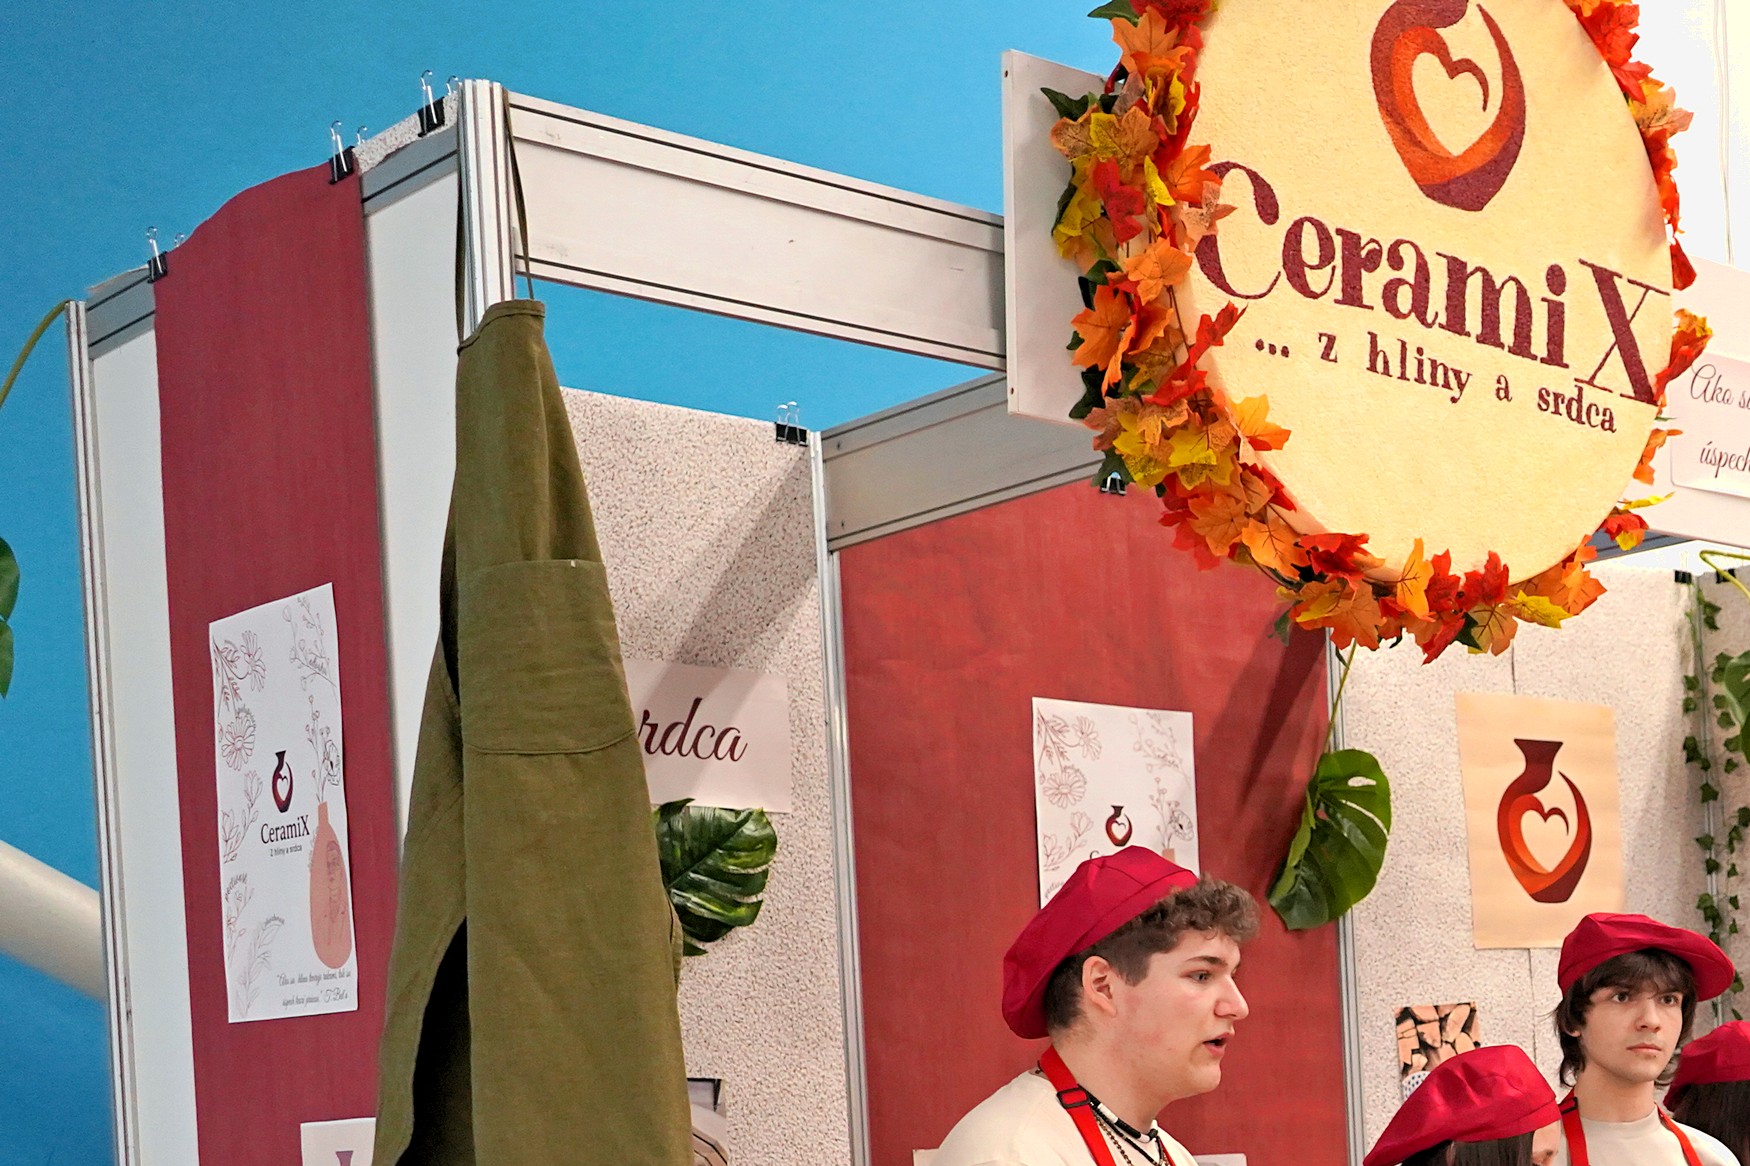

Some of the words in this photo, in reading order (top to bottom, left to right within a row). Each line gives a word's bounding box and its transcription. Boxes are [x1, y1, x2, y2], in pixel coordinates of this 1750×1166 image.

[1194, 161, 1671, 407] CeramiX
[1318, 332, 1338, 363] z
[1366, 332, 1472, 405] hliny
[1495, 375, 1513, 402] a
[1537, 382, 1618, 433] srdca
[1690, 363, 1734, 405] Ako
[638, 697, 748, 762] rdca
[261, 814, 310, 844] CeramiX
